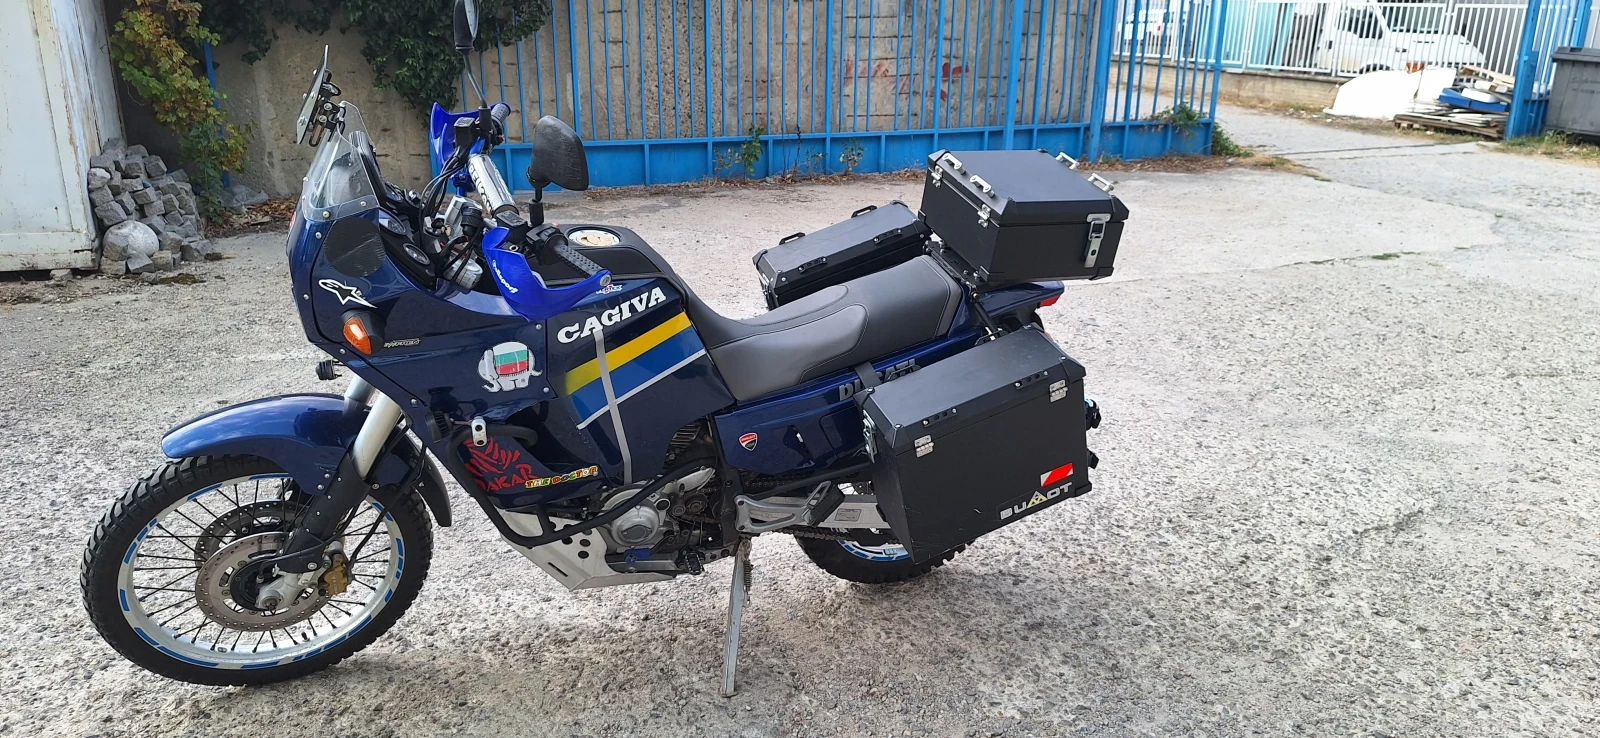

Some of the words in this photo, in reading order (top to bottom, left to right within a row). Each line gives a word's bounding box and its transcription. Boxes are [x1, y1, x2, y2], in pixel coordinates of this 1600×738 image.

[557, 286, 667, 344] CAGIVA
[525, 478, 552, 489] THE
[551, 465, 599, 485] DOCTOR
